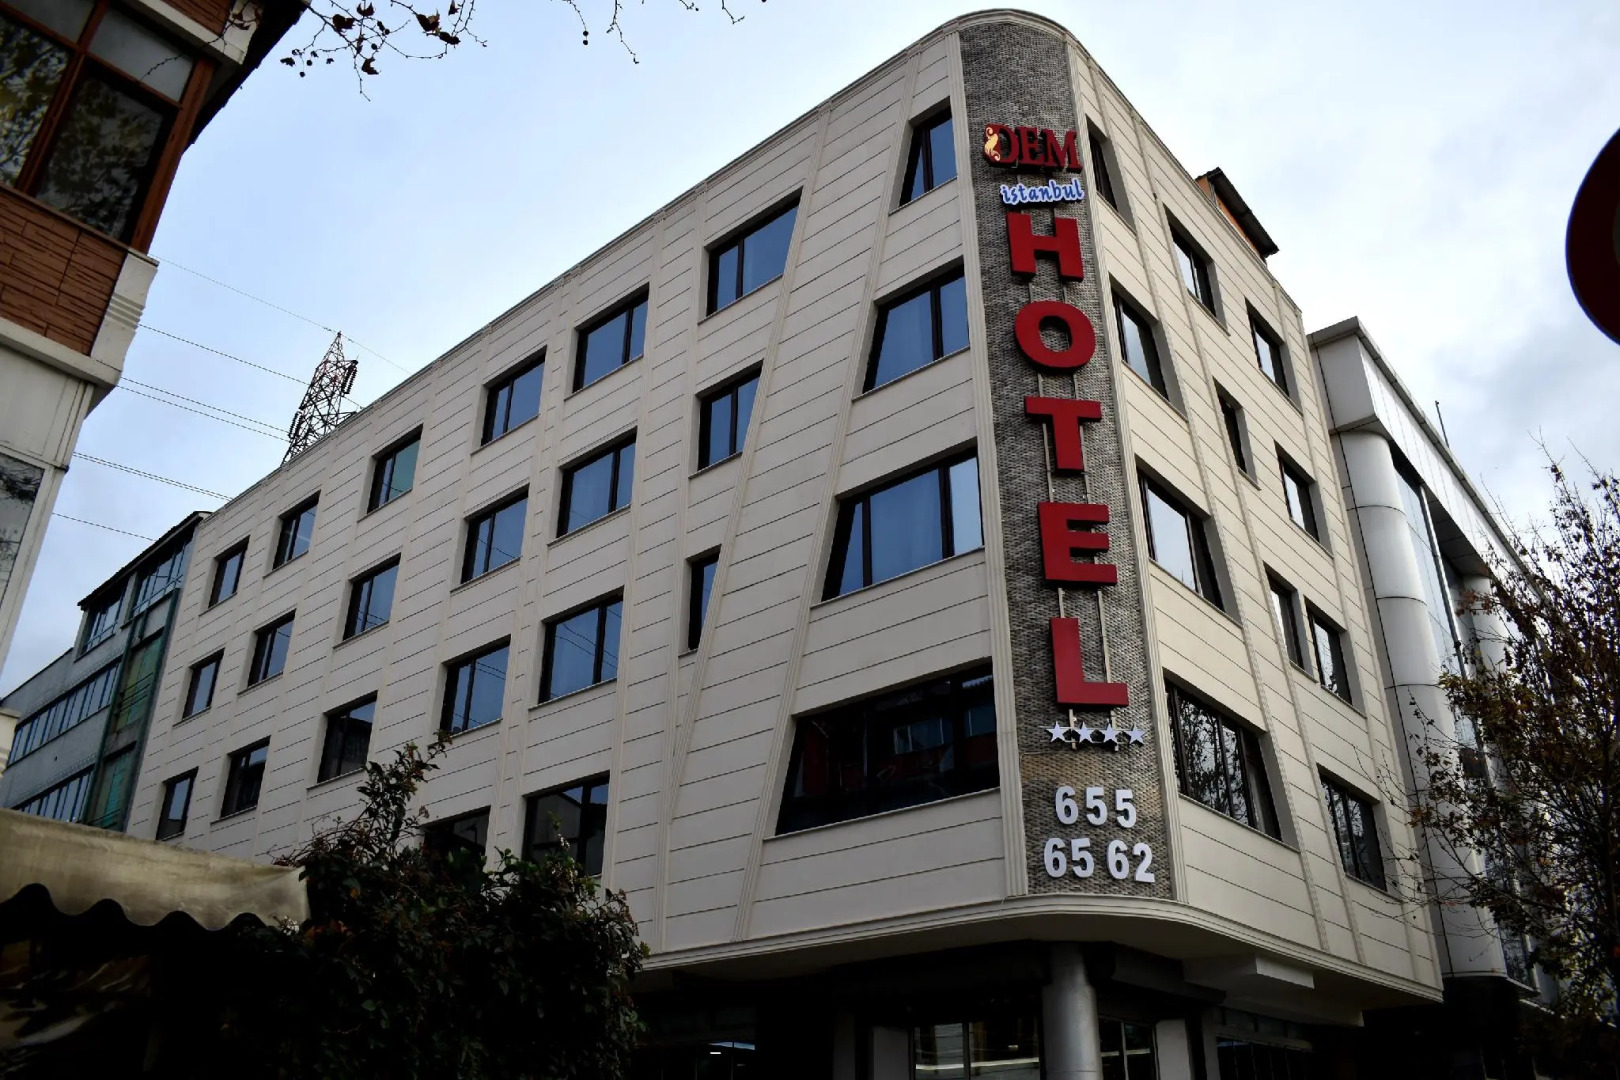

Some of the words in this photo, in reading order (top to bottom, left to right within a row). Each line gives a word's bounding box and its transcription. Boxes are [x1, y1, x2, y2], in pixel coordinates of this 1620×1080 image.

[983, 123, 1083, 172] DEM
[1001, 179, 1085, 204] istanbul
[1006, 212, 1129, 706] HOTEL
[1055, 785, 1137, 828] 655
